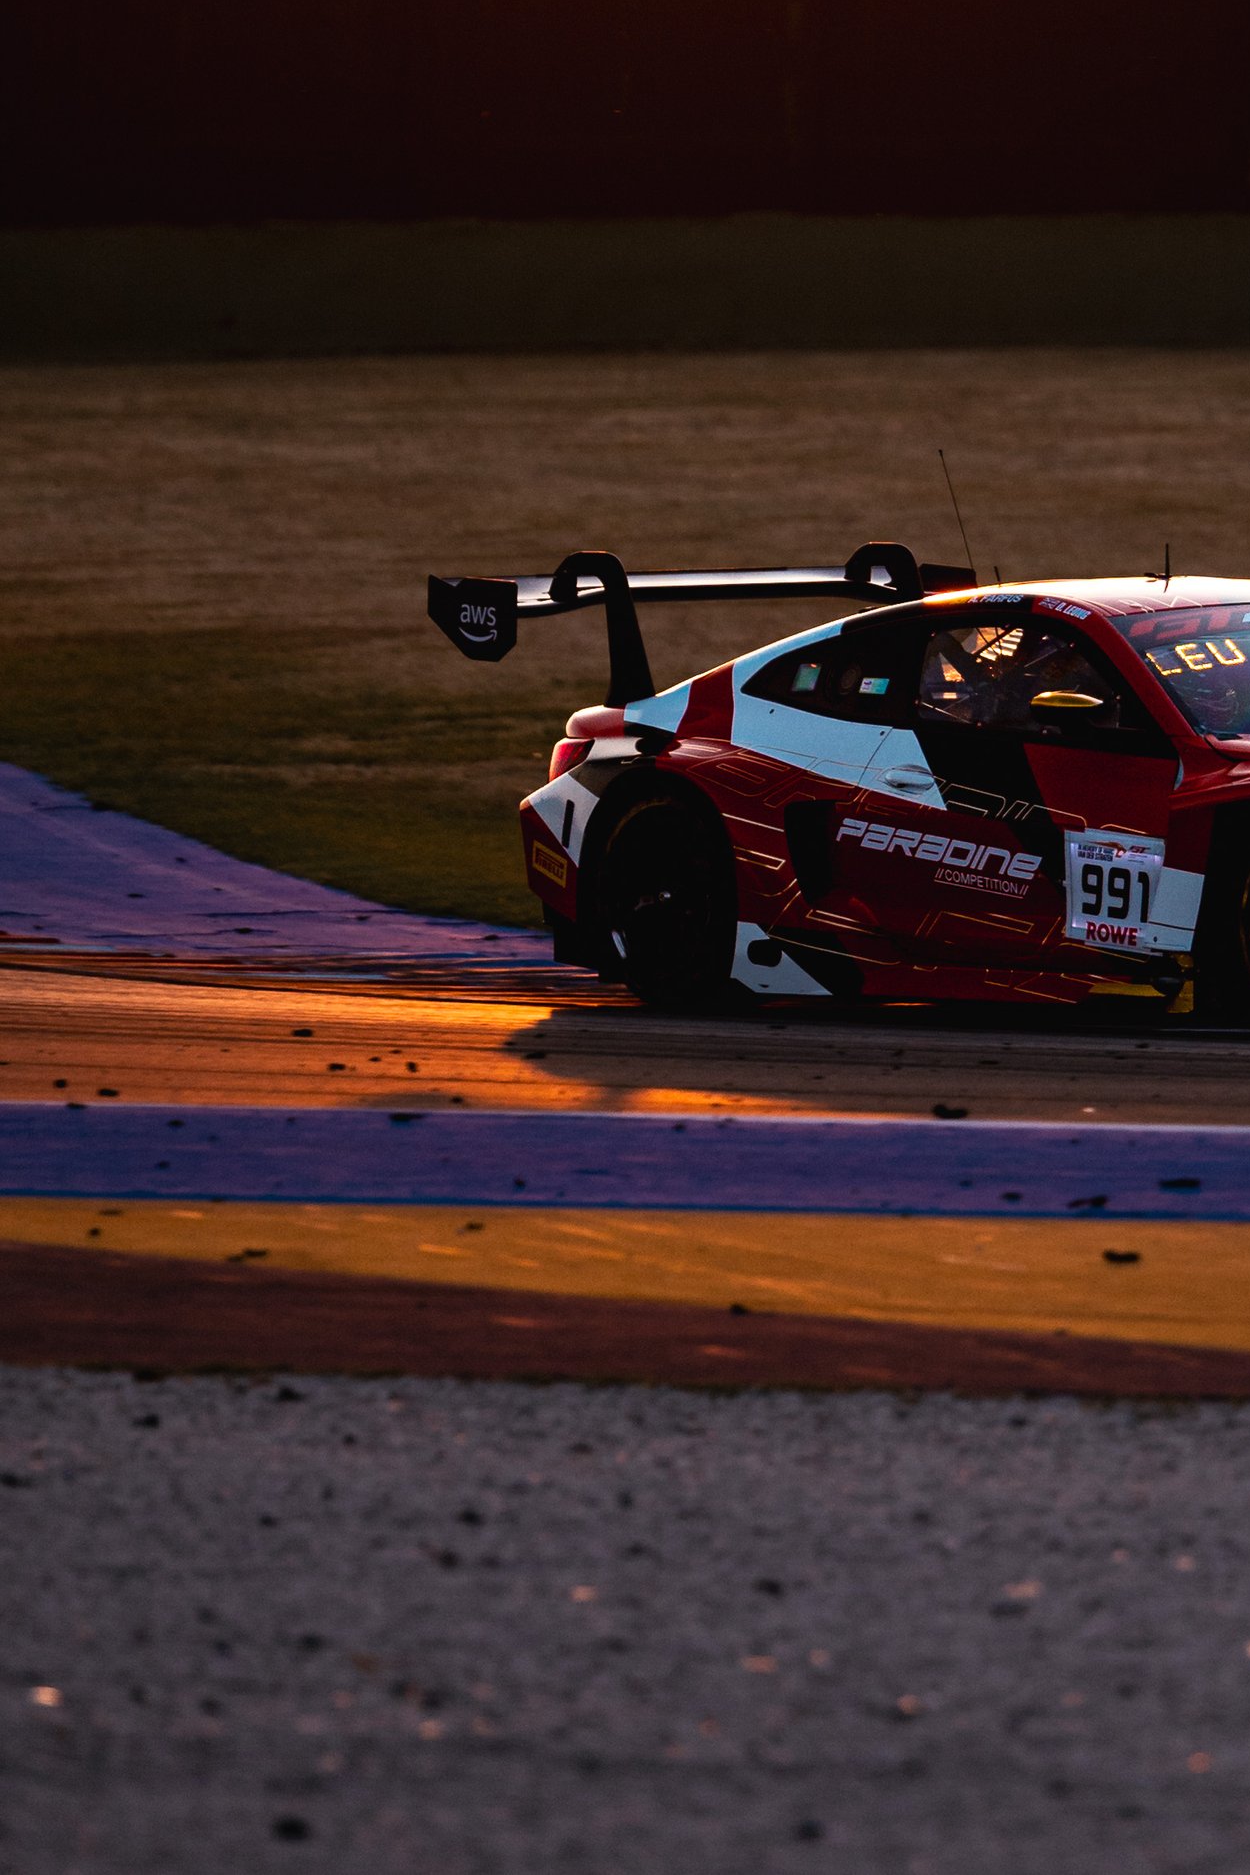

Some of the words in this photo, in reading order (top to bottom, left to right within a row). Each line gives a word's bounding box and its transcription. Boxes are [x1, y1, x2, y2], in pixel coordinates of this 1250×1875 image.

[460, 603, 497, 626] aws
[1145, 638, 1247, 676] LEU
[835, 817, 1043, 880] PARADINE
[1081, 863, 1150, 923] 991
[1086, 921, 1139, 947] ROWE
